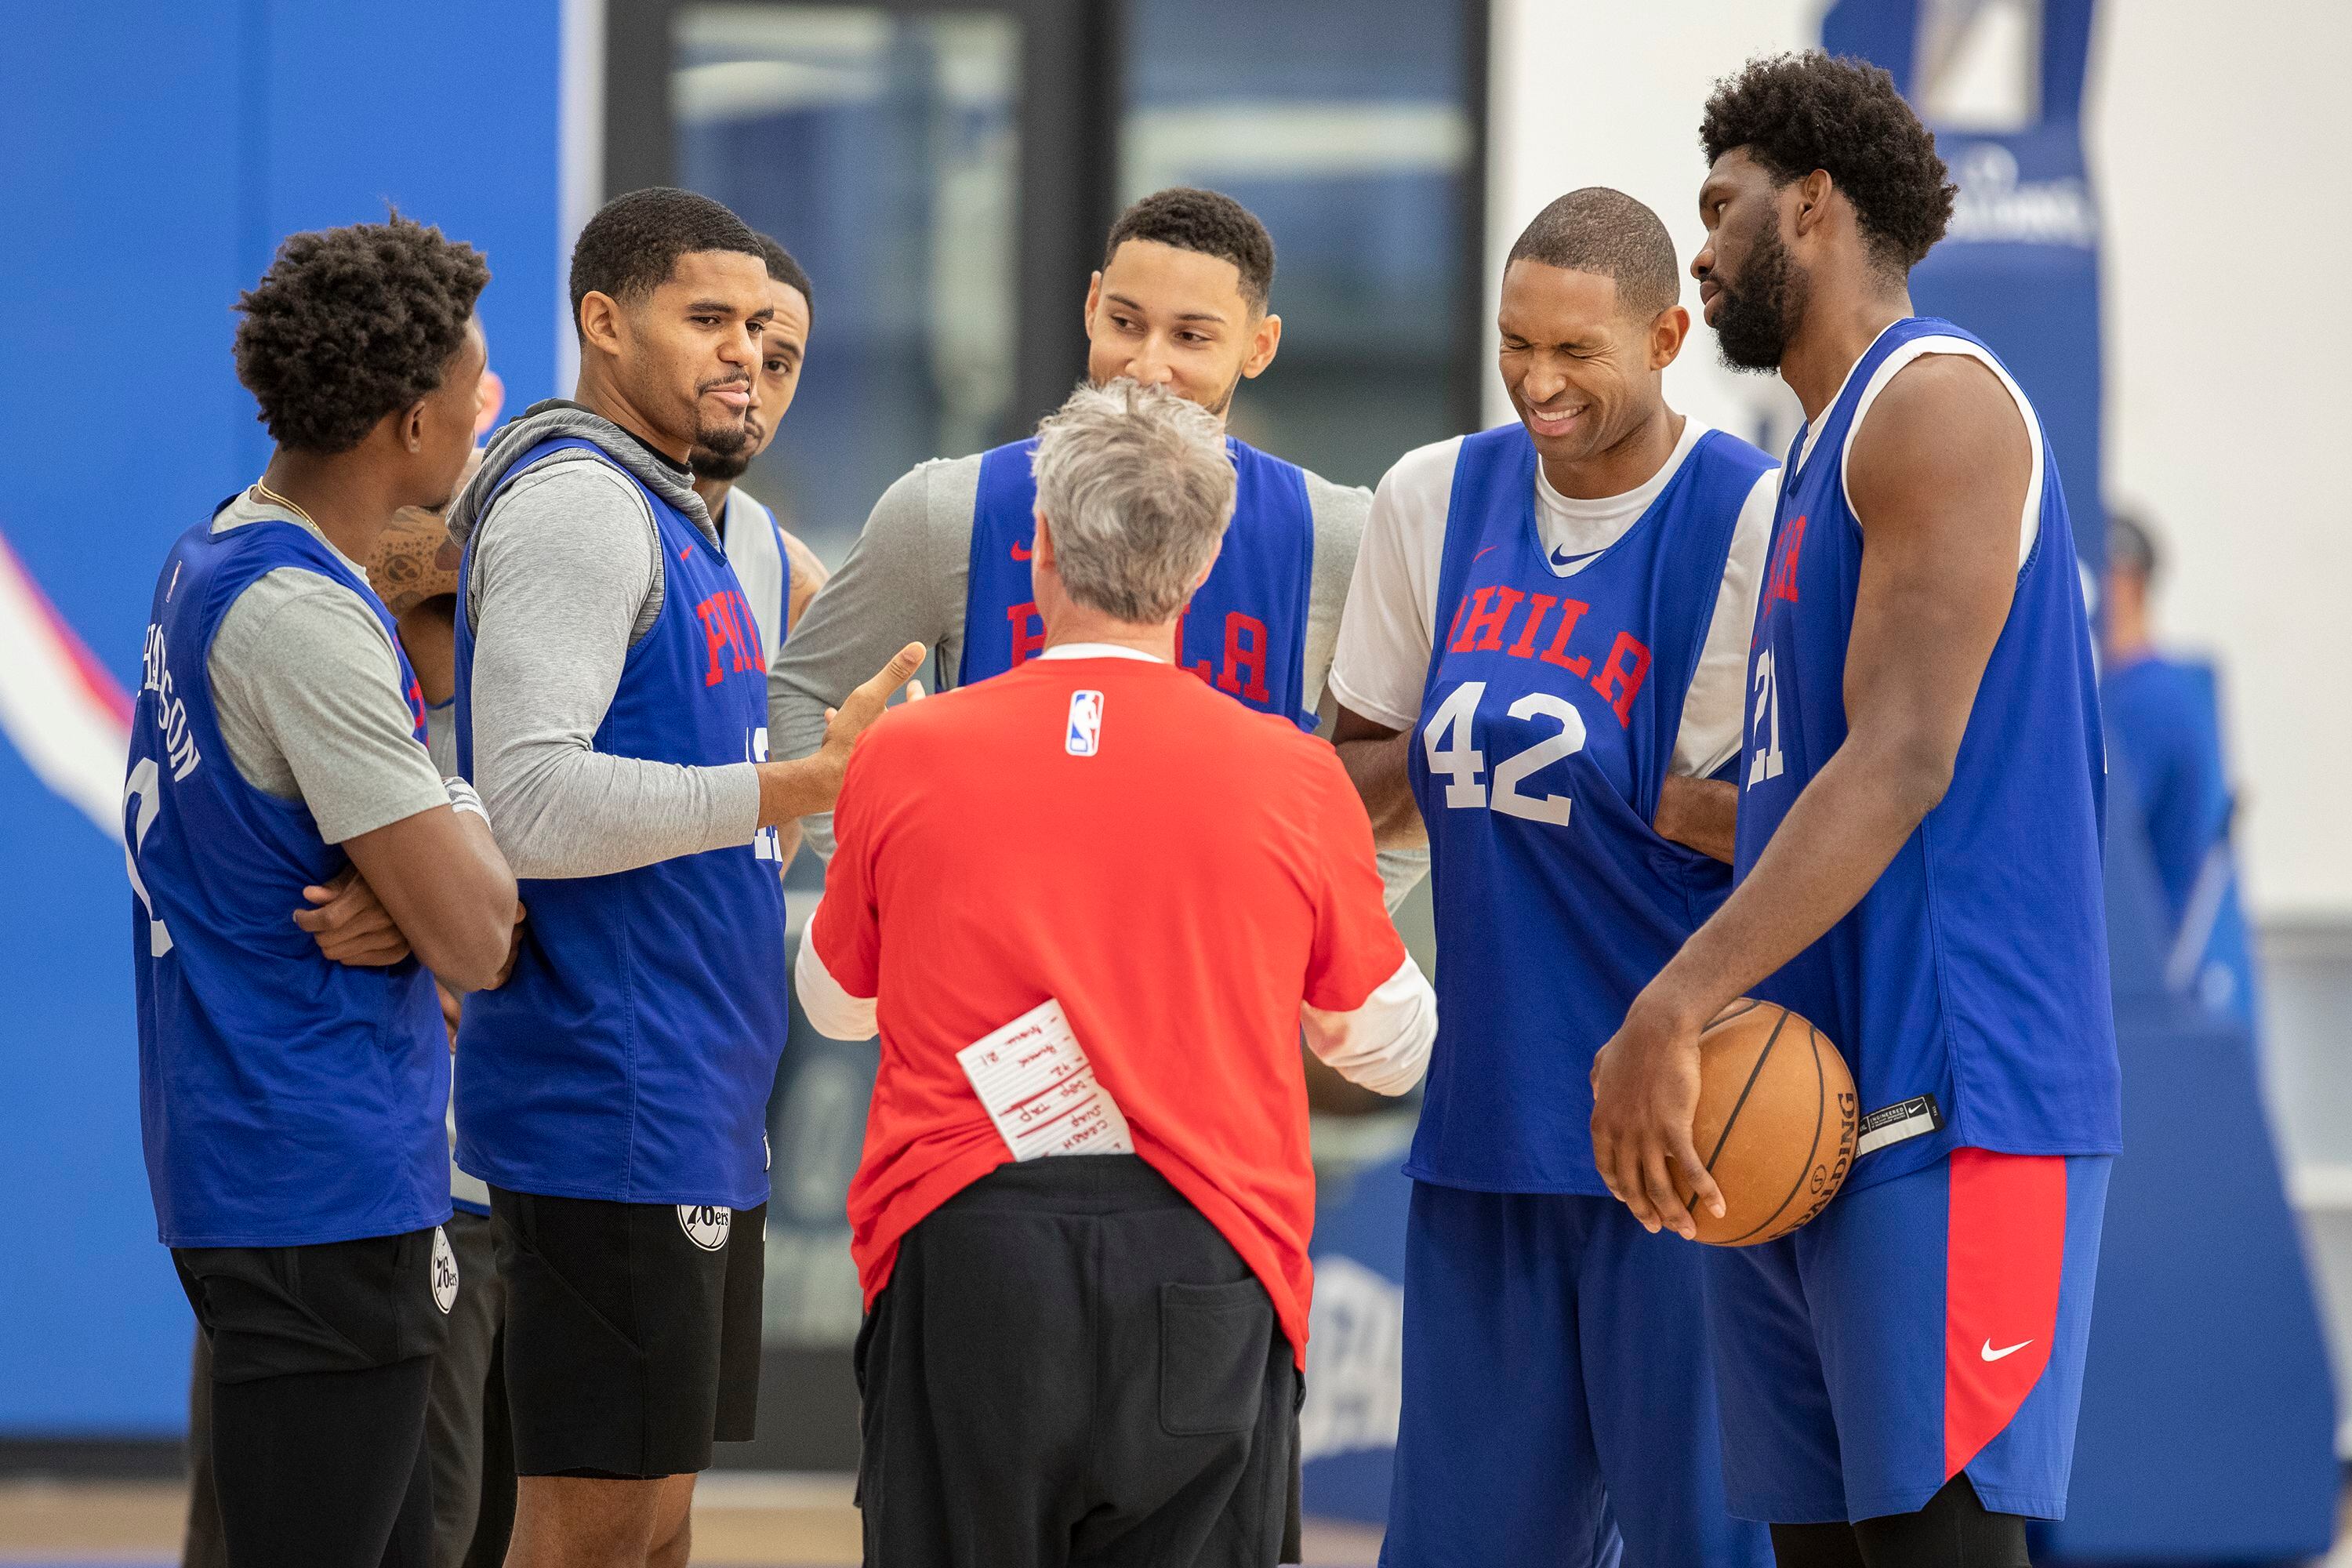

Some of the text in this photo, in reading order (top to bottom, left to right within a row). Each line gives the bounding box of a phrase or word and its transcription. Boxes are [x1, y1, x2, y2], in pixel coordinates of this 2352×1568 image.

[1440, 586, 1651, 729] HILA
[1747, 642, 1784, 792] 21
[1424, 681, 1586, 826] 42
